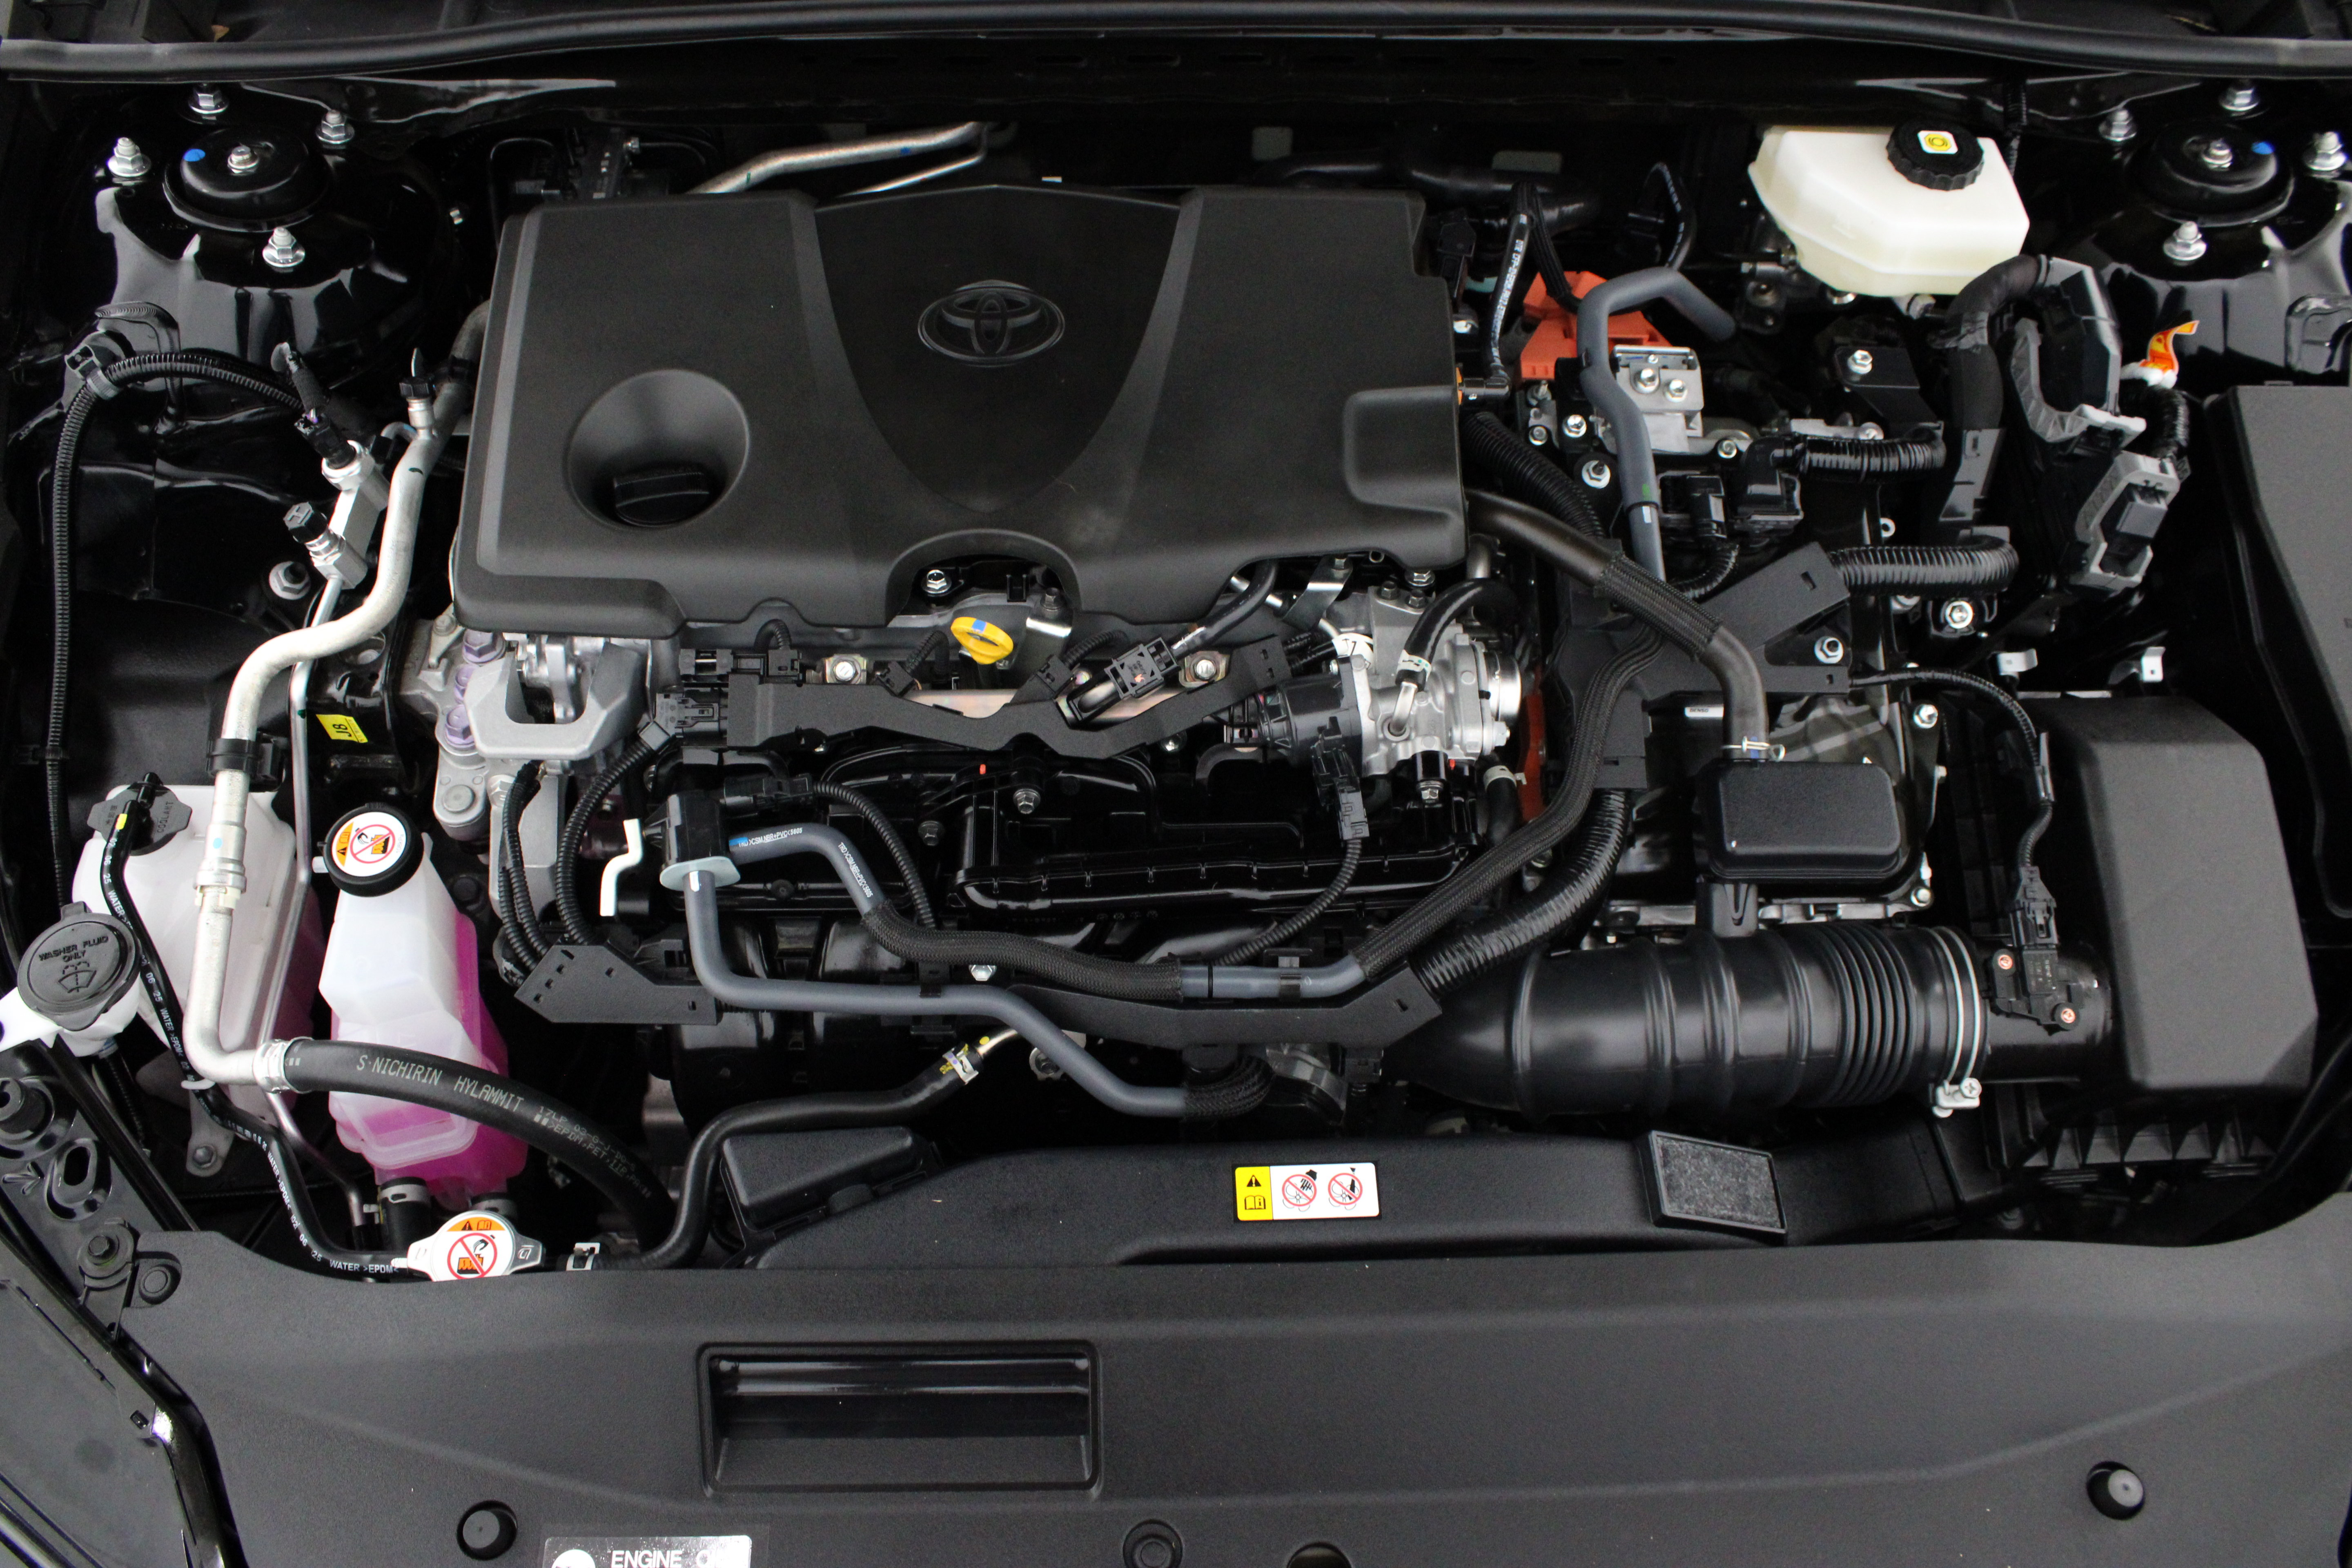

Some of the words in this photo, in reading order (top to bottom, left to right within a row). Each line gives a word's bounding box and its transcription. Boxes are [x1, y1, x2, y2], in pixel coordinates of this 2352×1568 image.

[332, 724, 352, 737] J8
[108, 889, 125, 917] WATER
[39, 944, 78, 961] WASHER
[83, 936, 109, 949] FLUID
[63, 950, 86, 962] ONLY
[160, 1007, 174, 1031] WATER
[454, 1076, 524, 1112] HYLAMMIT
[267, 1151, 279, 1178] WATER
[329, 1259, 360, 1272] WATER
[611, 1550, 683, 1568] ENGINE
